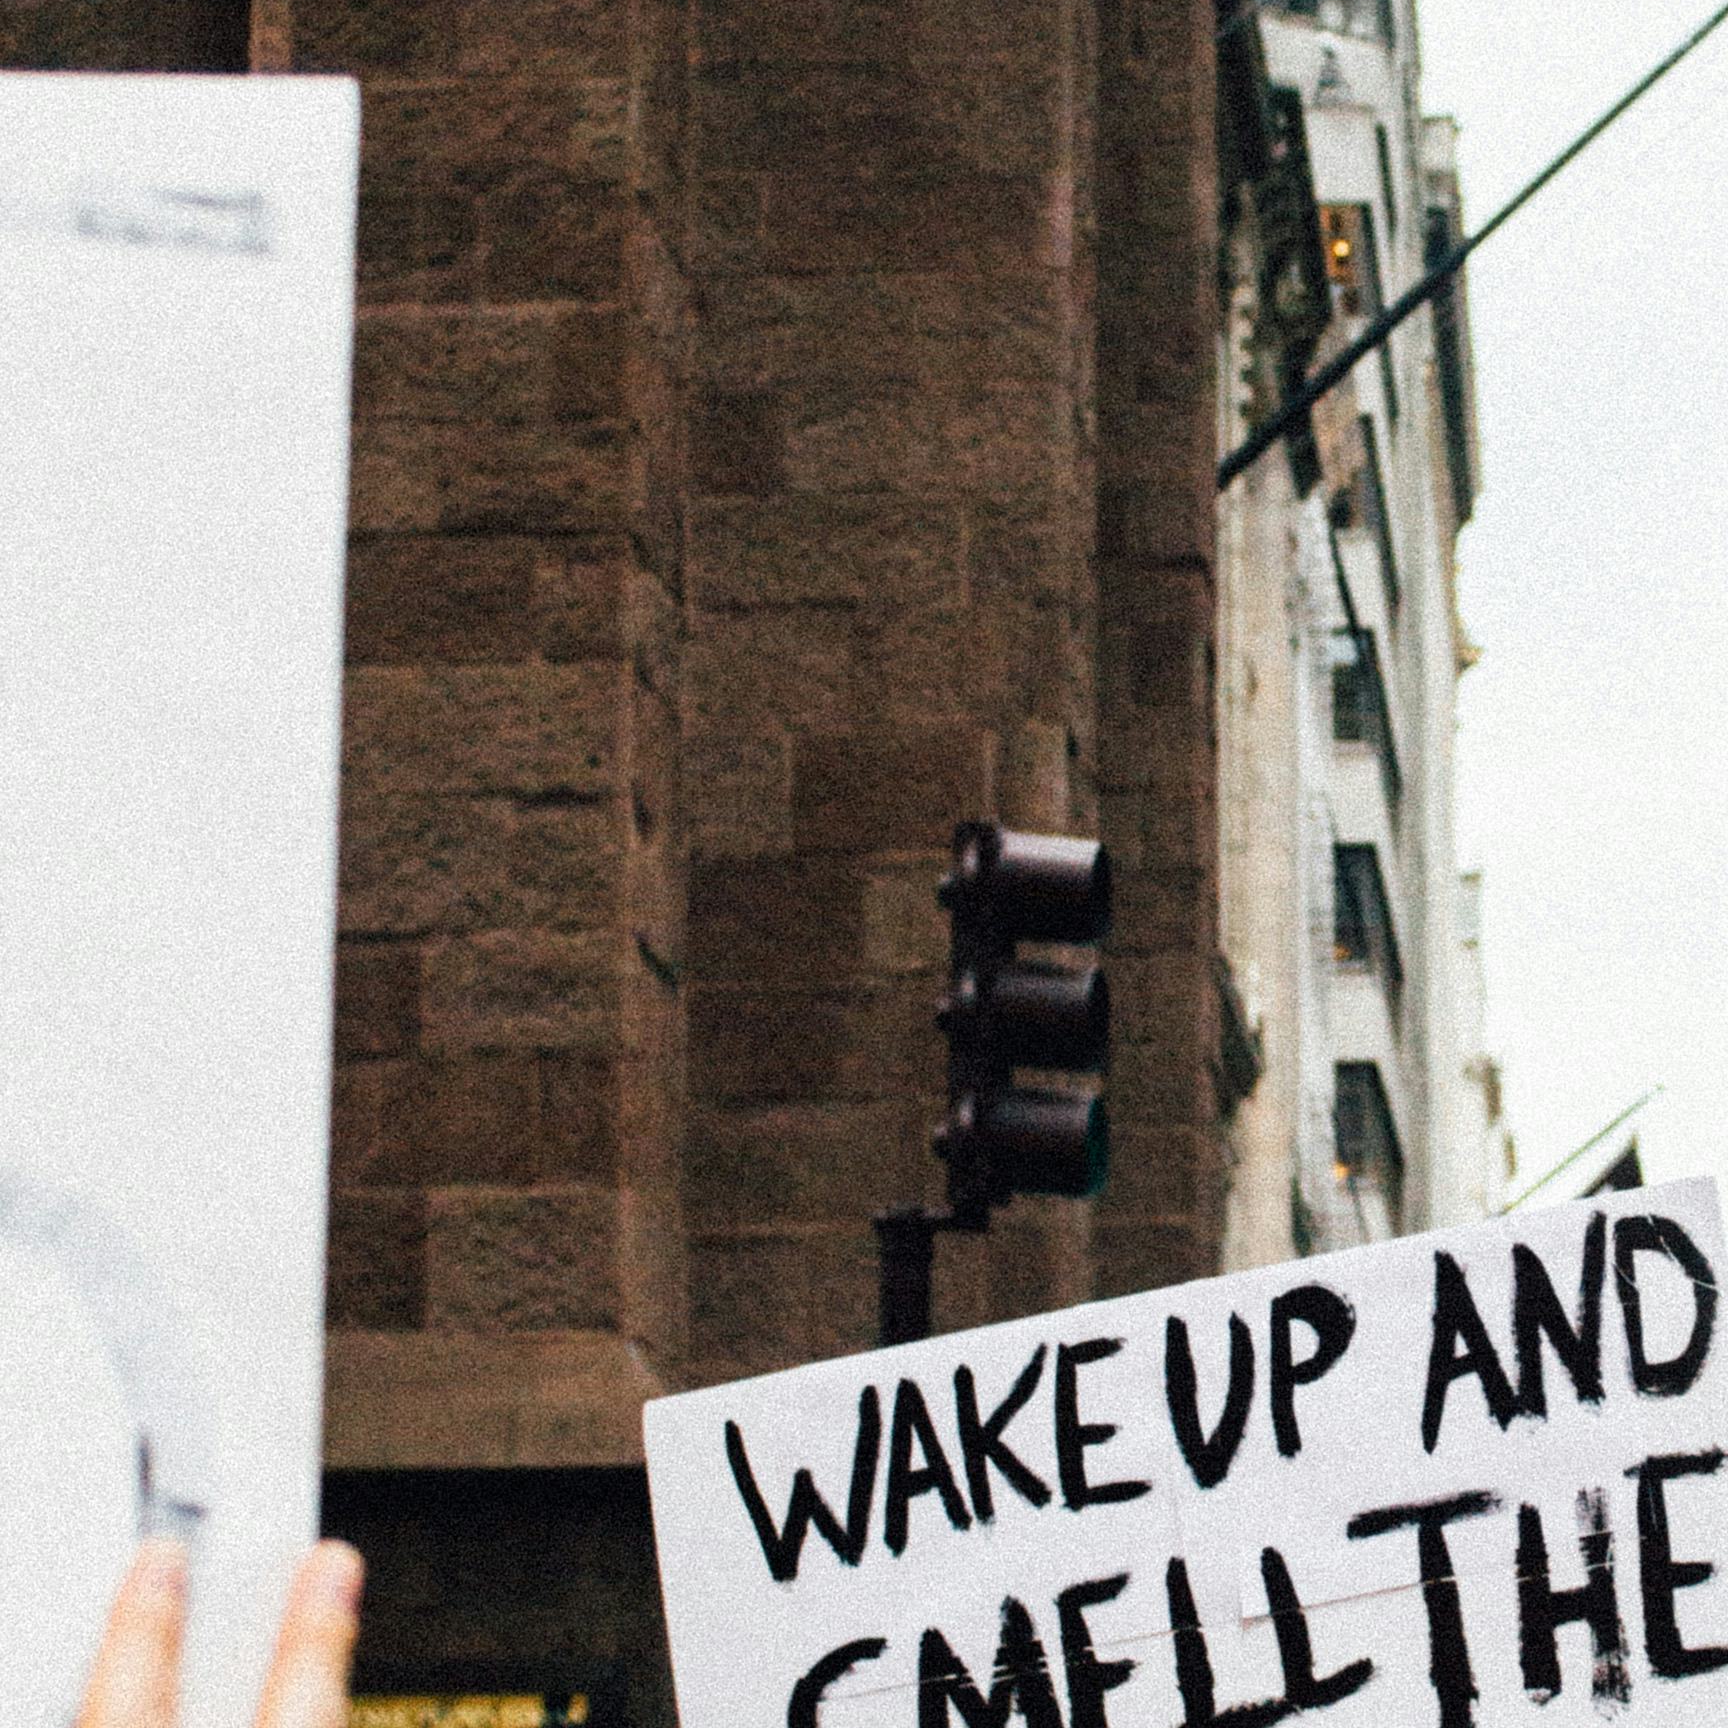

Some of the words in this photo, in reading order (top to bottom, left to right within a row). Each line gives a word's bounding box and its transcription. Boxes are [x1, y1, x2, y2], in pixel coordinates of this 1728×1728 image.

[723, 1336, 1153, 1583] WAKE
[1164, 1283, 1358, 1489] UP
[1420, 1210, 1722, 1456] AND
